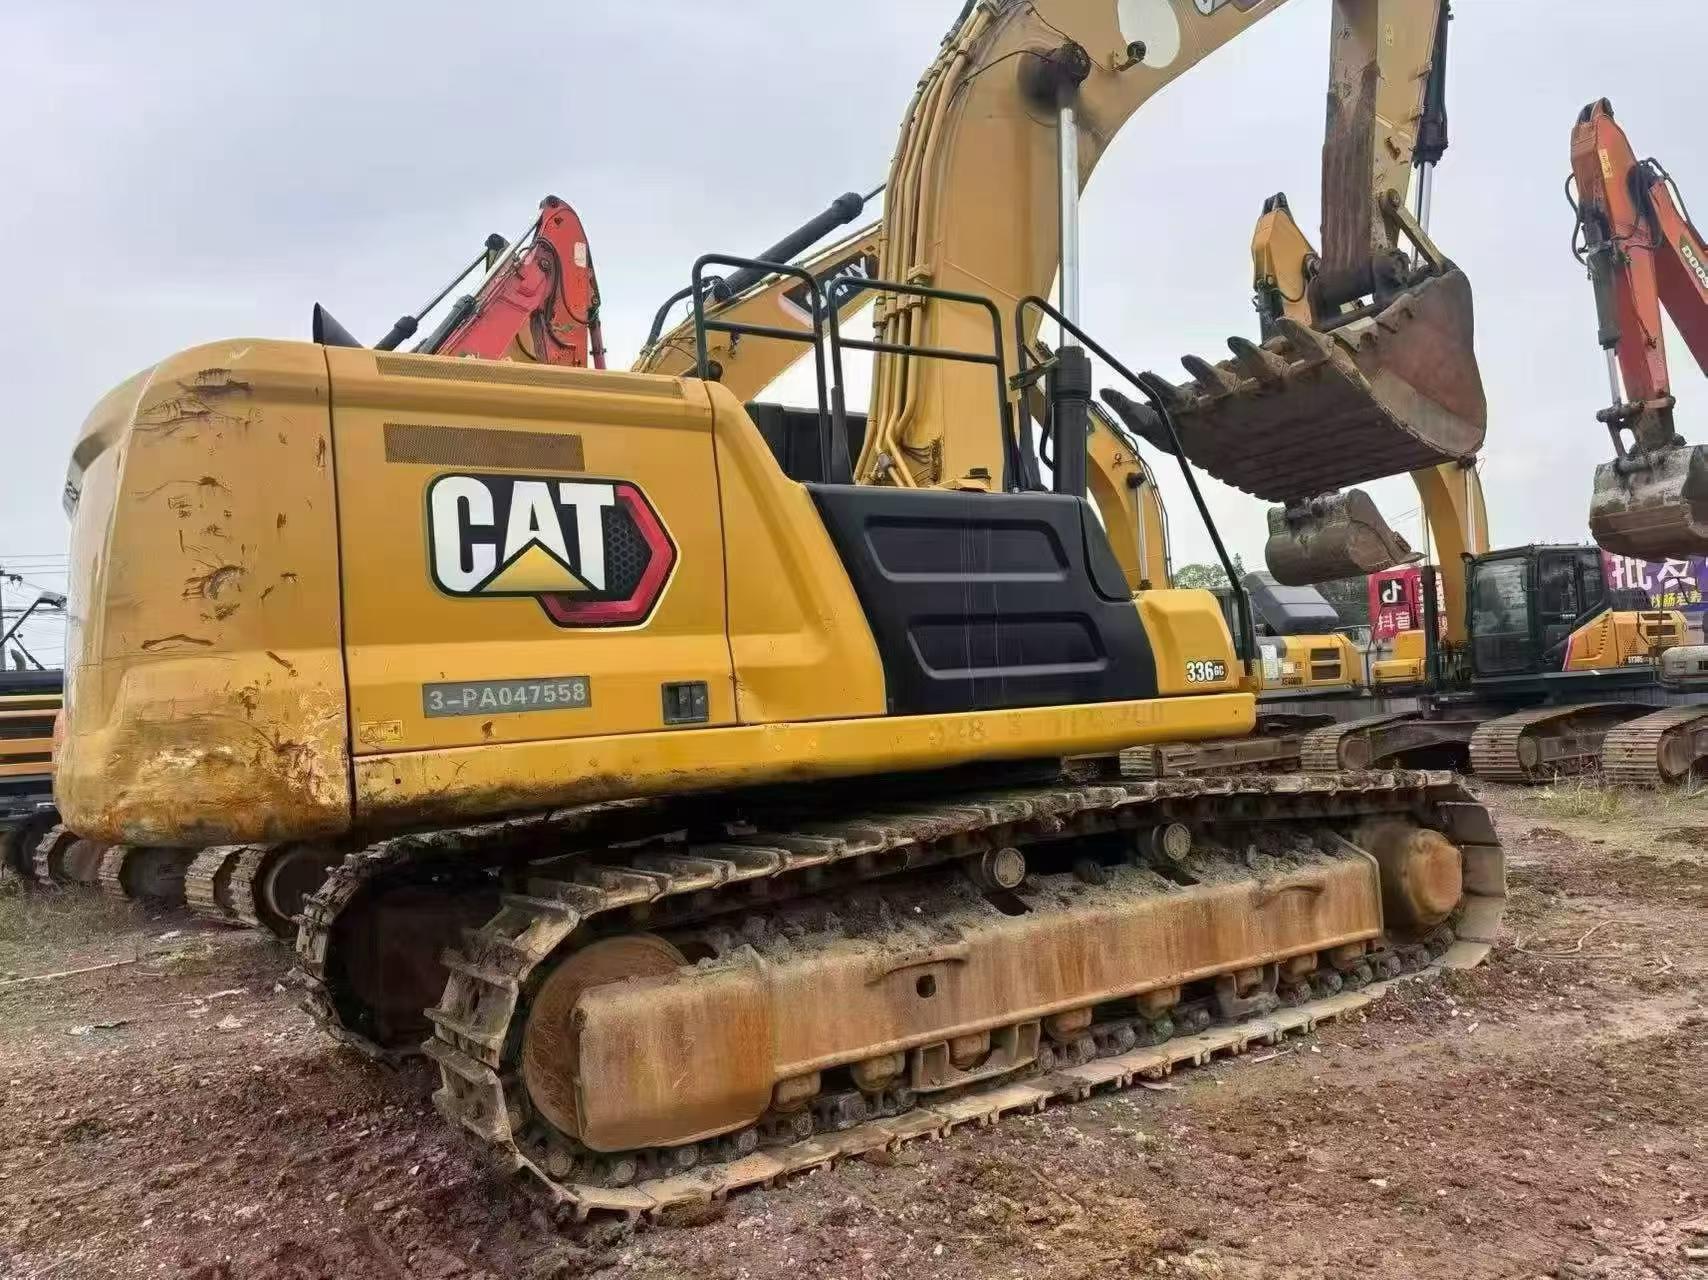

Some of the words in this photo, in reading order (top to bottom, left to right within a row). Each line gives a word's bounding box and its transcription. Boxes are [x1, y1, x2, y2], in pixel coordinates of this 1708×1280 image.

[431, 475, 615, 592] CAT
[1378, 611, 1411, 631] 抖音
[429, 683, 586, 711] 3-PA047558
